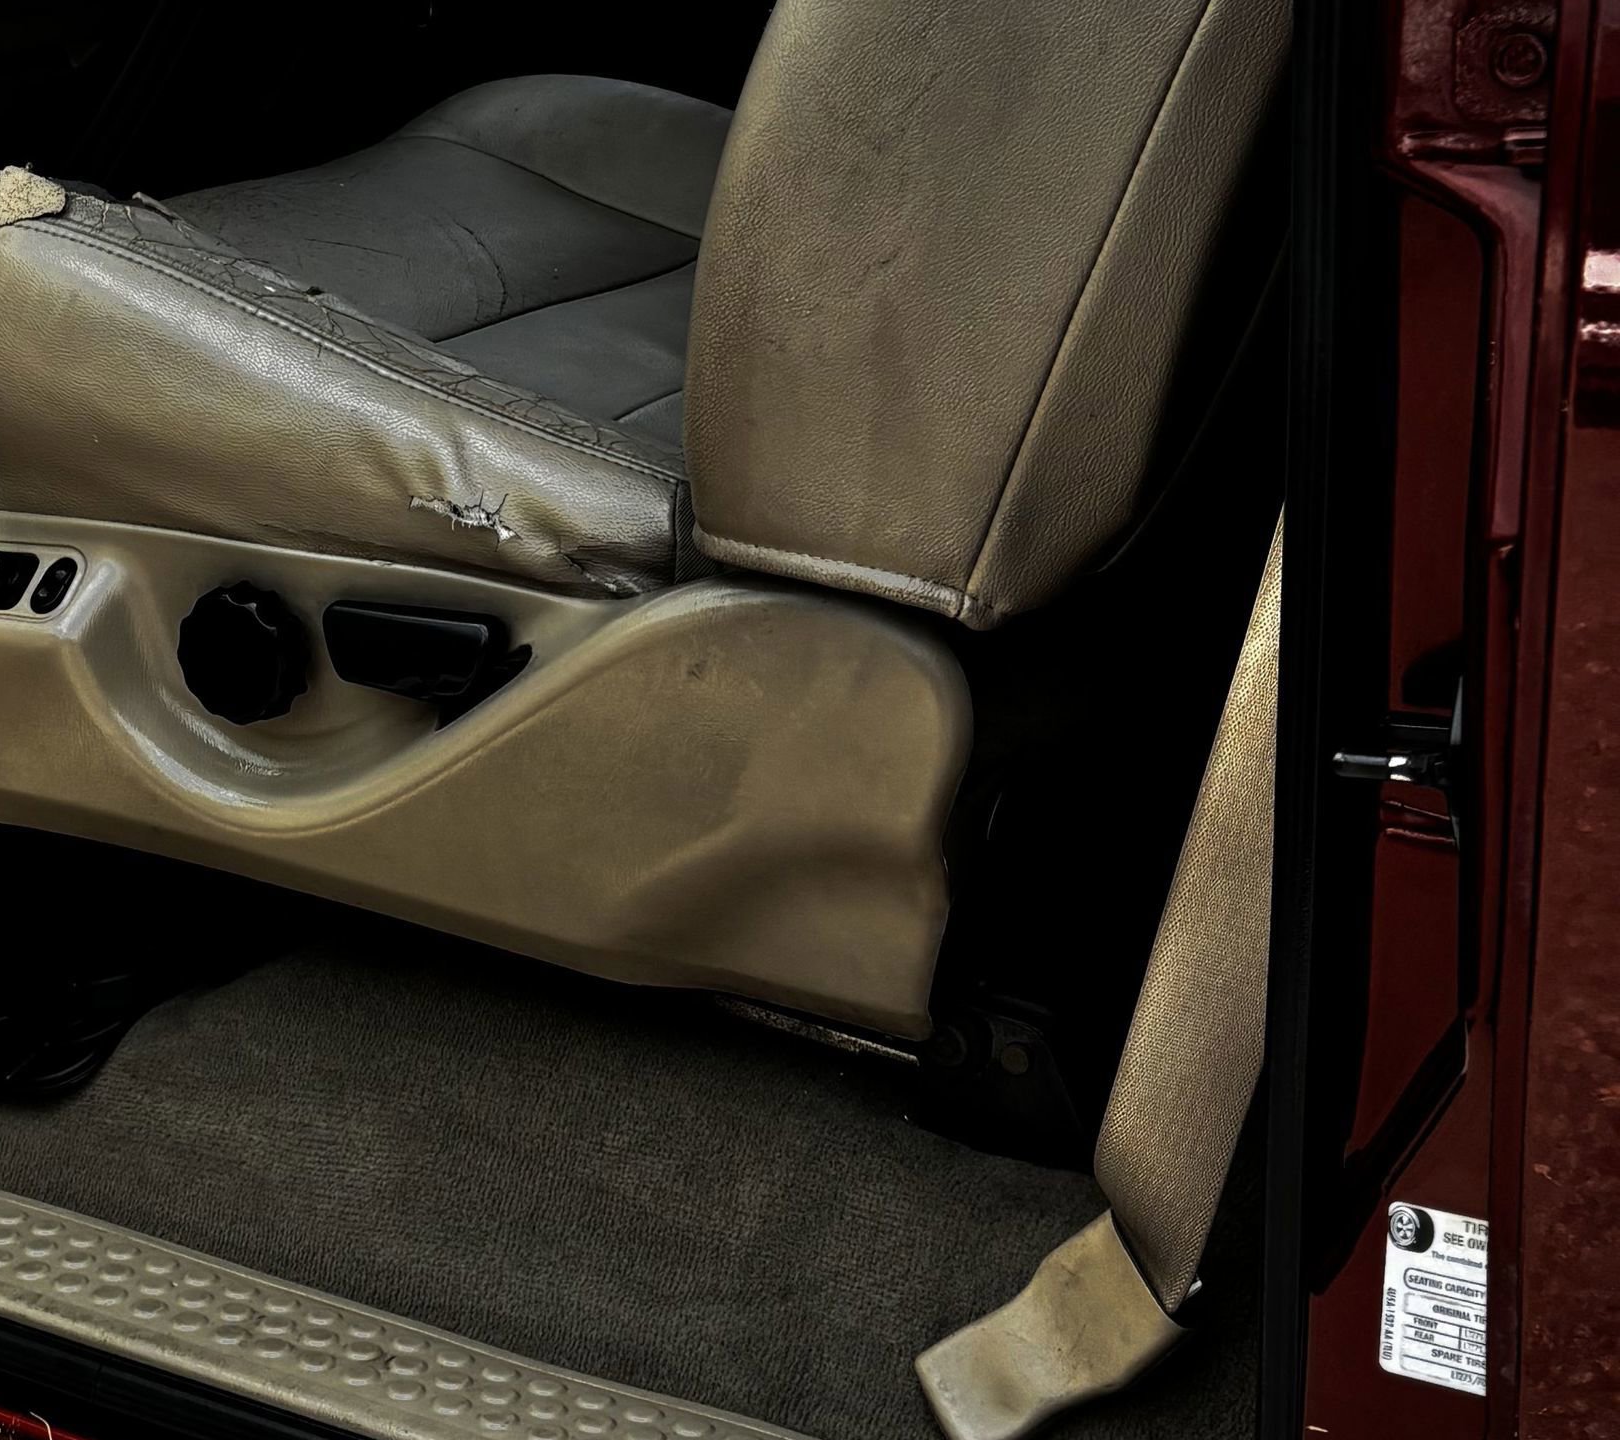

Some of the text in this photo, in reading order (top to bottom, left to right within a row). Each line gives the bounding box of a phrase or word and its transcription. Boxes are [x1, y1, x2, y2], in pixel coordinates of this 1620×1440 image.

[1443, 1232, 1464, 1247] SEE
[1408, 1274, 1485, 1299] SEATING CAPACITY
[1432, 1305, 1471, 1321] ORIGINAL
[1413, 1317, 1438, 1329] FRONT
[1414, 1330, 1435, 1342] REAR
[1431, 1348, 1463, 1363] SPARE
